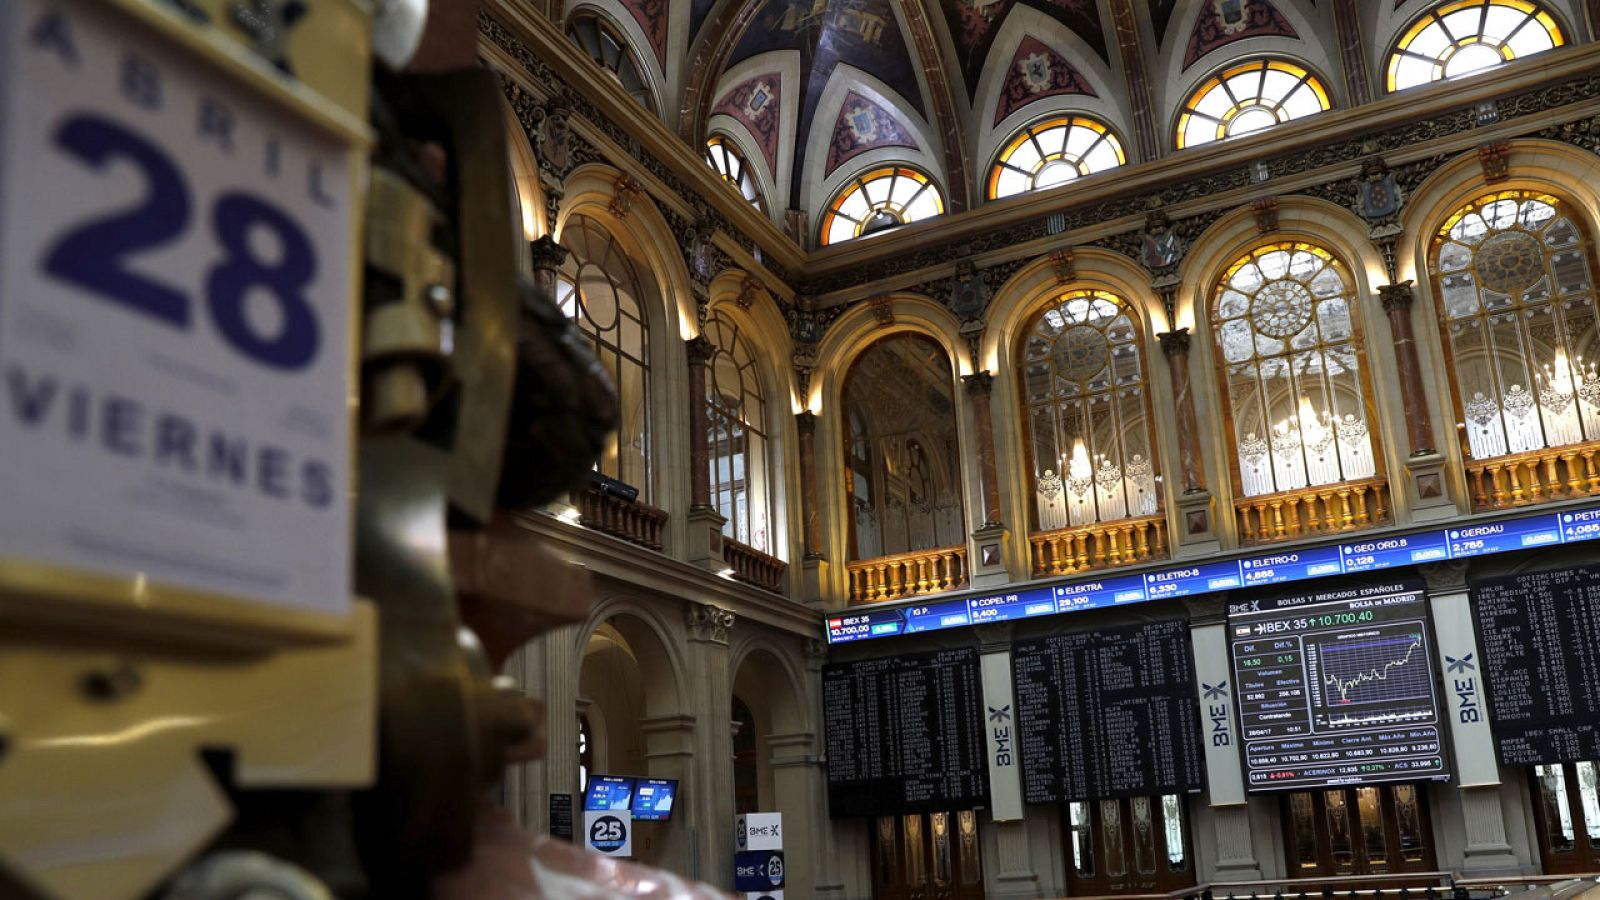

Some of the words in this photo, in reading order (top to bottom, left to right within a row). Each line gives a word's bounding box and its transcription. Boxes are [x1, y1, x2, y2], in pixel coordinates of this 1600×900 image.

[31, 8, 337, 209] ABRIL
[39, 110, 321, 373] 28
[4, 365, 336, 511] VIERNES
[1460, 525, 1504, 538] GERDAU
[1354, 543, 1376, 554] GEO
[1378, 538, 1407, 550] ORD.B
[1252, 554, 1298, 568] ELETRO-O
[1156, 569, 1199, 581] ELETRO-B
[1065, 583, 1103, 595] ELEKTRA
[978, 597, 1004, 606] COPEL
[1006, 595, 1018, 603] PR
[1229, 604, 1249, 614] BME
[1277, 596, 1306, 607] BOLSAS
[1315, 591, 1357, 602] MERCADOS
[1360, 584, 1404, 596] ESPAÑOLES
[1349, 600, 1373, 609] BOLSA
[1383, 595, 1416, 606] MADRID
[843, 616, 860, 625] IBEX
[861, 615, 870, 623] 35
[1262, 621, 1291, 634] IBEX
[1294, 619, 1308, 630] 35
[1318, 610, 1373, 627] 10.700,40
[1455, 677, 1479, 724] BME
[1210, 703, 1229, 747] BME
[994, 725, 1011, 767] BME
[1303, 767, 1336, 777] ACERINOX
[1394, 761, 1408, 770] ACS
[594, 821, 621, 841] 25
[749, 827, 769, 836] BME
[737, 866, 755, 875] BME
[769, 860, 782, 876] 25
